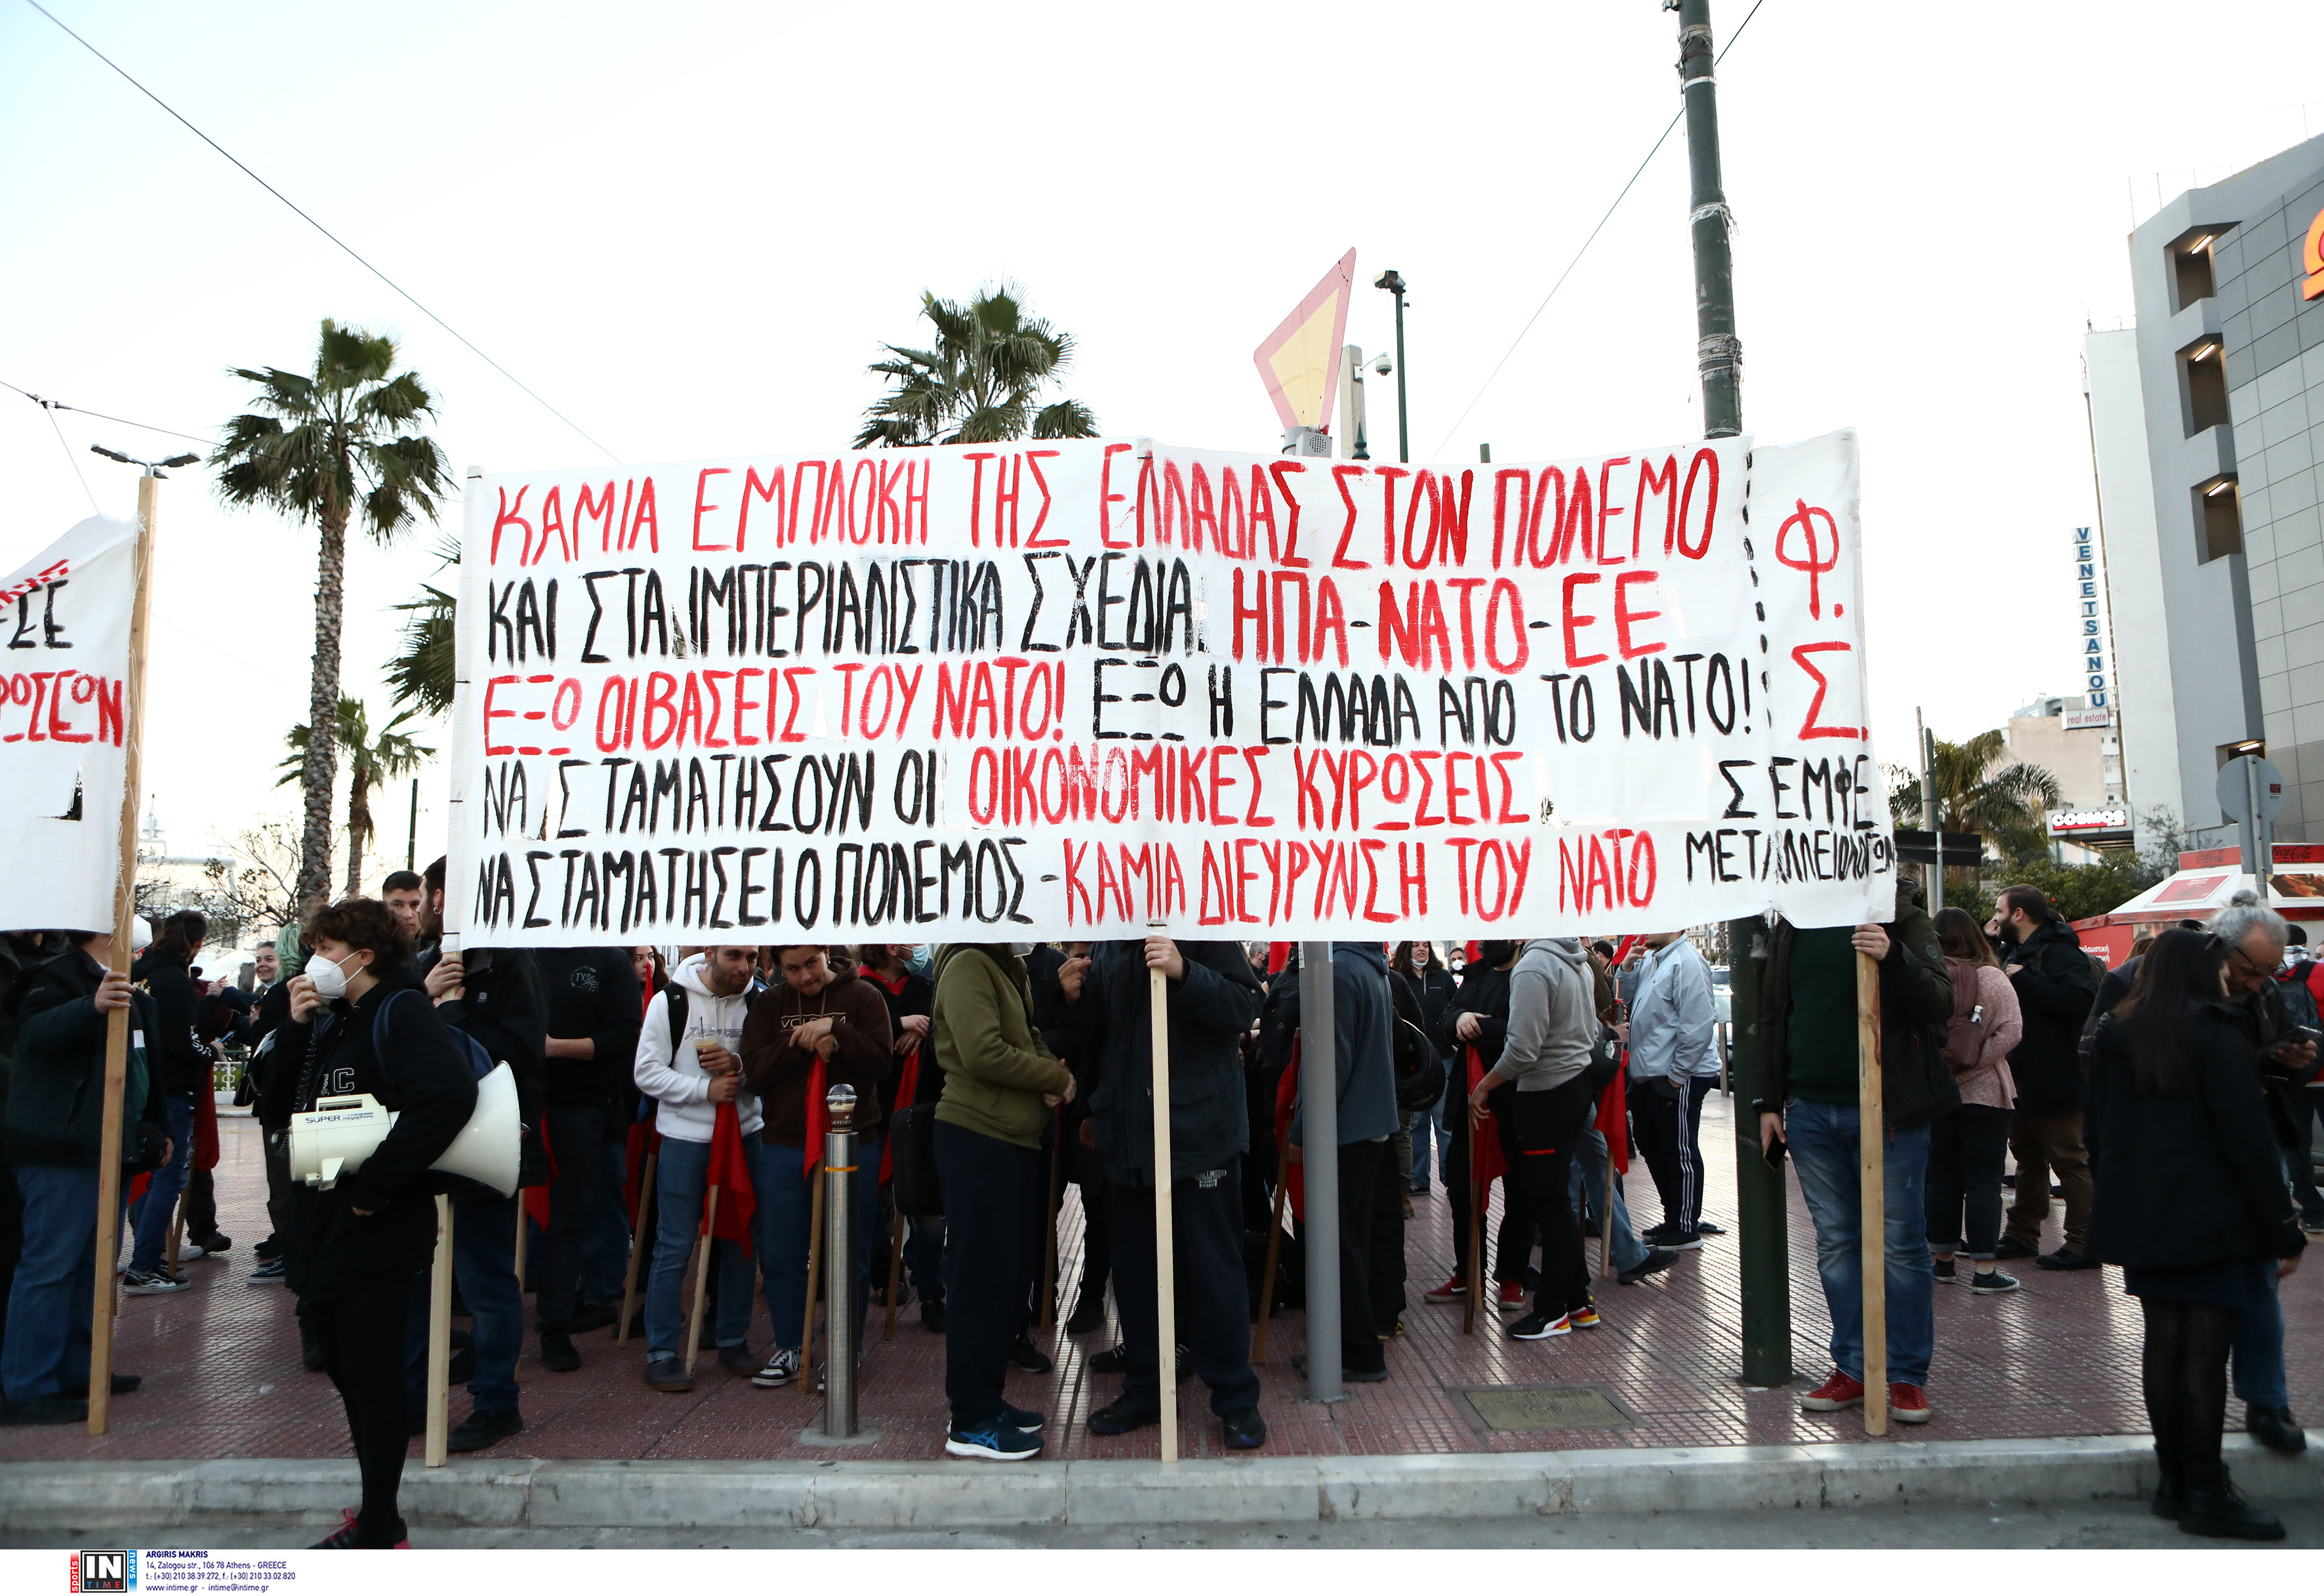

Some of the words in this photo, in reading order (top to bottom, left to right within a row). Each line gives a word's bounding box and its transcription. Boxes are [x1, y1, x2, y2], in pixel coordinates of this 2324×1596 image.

[491, 477, 659, 566] ΚΑΜΙΑ
[693, 459, 929, 552] ΕΜΠΛΟΚΗ
[964, 451, 1070, 548] ΤΗΣ
[1100, 443, 1310, 569] ΕΛΛΑΔΑΣ
[1332, 462, 1473, 570] ΣΤΟΝ
[1492, 448, 1719, 571] ΠΟΛΕΜΟ
[489, 576, 557, 669] ΚΑΙ
[579, 568, 666, 663] ΣΤΑ
[689, 559, 1002, 657] ΙΜΠΕΡΙΑΛΙΣΤΙΚΑ
[1021, 552, 1193, 657] ΣΧΕΔΙΑ
[2076, 527, 2106, 706] VENETSANOU
[484, 674, 582, 756] ΕΞΩ
[834, 663, 923, 740] ΤΟΥ
[933, 657, 1065, 744] ΝΑΤΟ!
[1093, 658, 1187, 741] ΕΞΩ
[1208, 661, 1233, 737] Η
[1261, 668, 1420, 746] ΕΛΛΑΔΑ
[1439, 673, 1515, 750] ΑΠΟ
[1539, 674, 1595, 746] ΤΟ
[1618, 653, 1750, 738] ΝΑΤΟ!
[2067, 712, 2082, 724] real
[2084, 712, 2106, 723] estate
[485, 761, 525, 840] ΝΑ
[558, 752, 874, 838] ΣΤΑΜΑΤΗΣΟΥΝ
[894, 750, 936, 827] ΟΙ
[969, 741, 1274, 827] ΟΙΚΟΝΟΜΙΚΕΣ
[1294, 747, 1530, 831] ΚΥΡΩΣΕΙΣ
[2052, 809, 2125, 827] COSMOS
[474, 849, 514, 928] ΝΑ
[523, 847, 783, 933] ΣΤΑΜΑΤΗΣΕΙ
[795, 849, 820, 930] Ο
[833, 836, 1032, 929] ΠΟΛΕΜΟΣ
[1198, 838, 1427, 926] ΔΙΕΥΡΥΝΣΗ
[1445, 837, 1531, 922] ΤΟΥ
[1559, 829, 1656, 916] ΝΑΤΟ
[306, 1115, 341, 1124] SUPER
[333, 1067, 355, 1093] C
